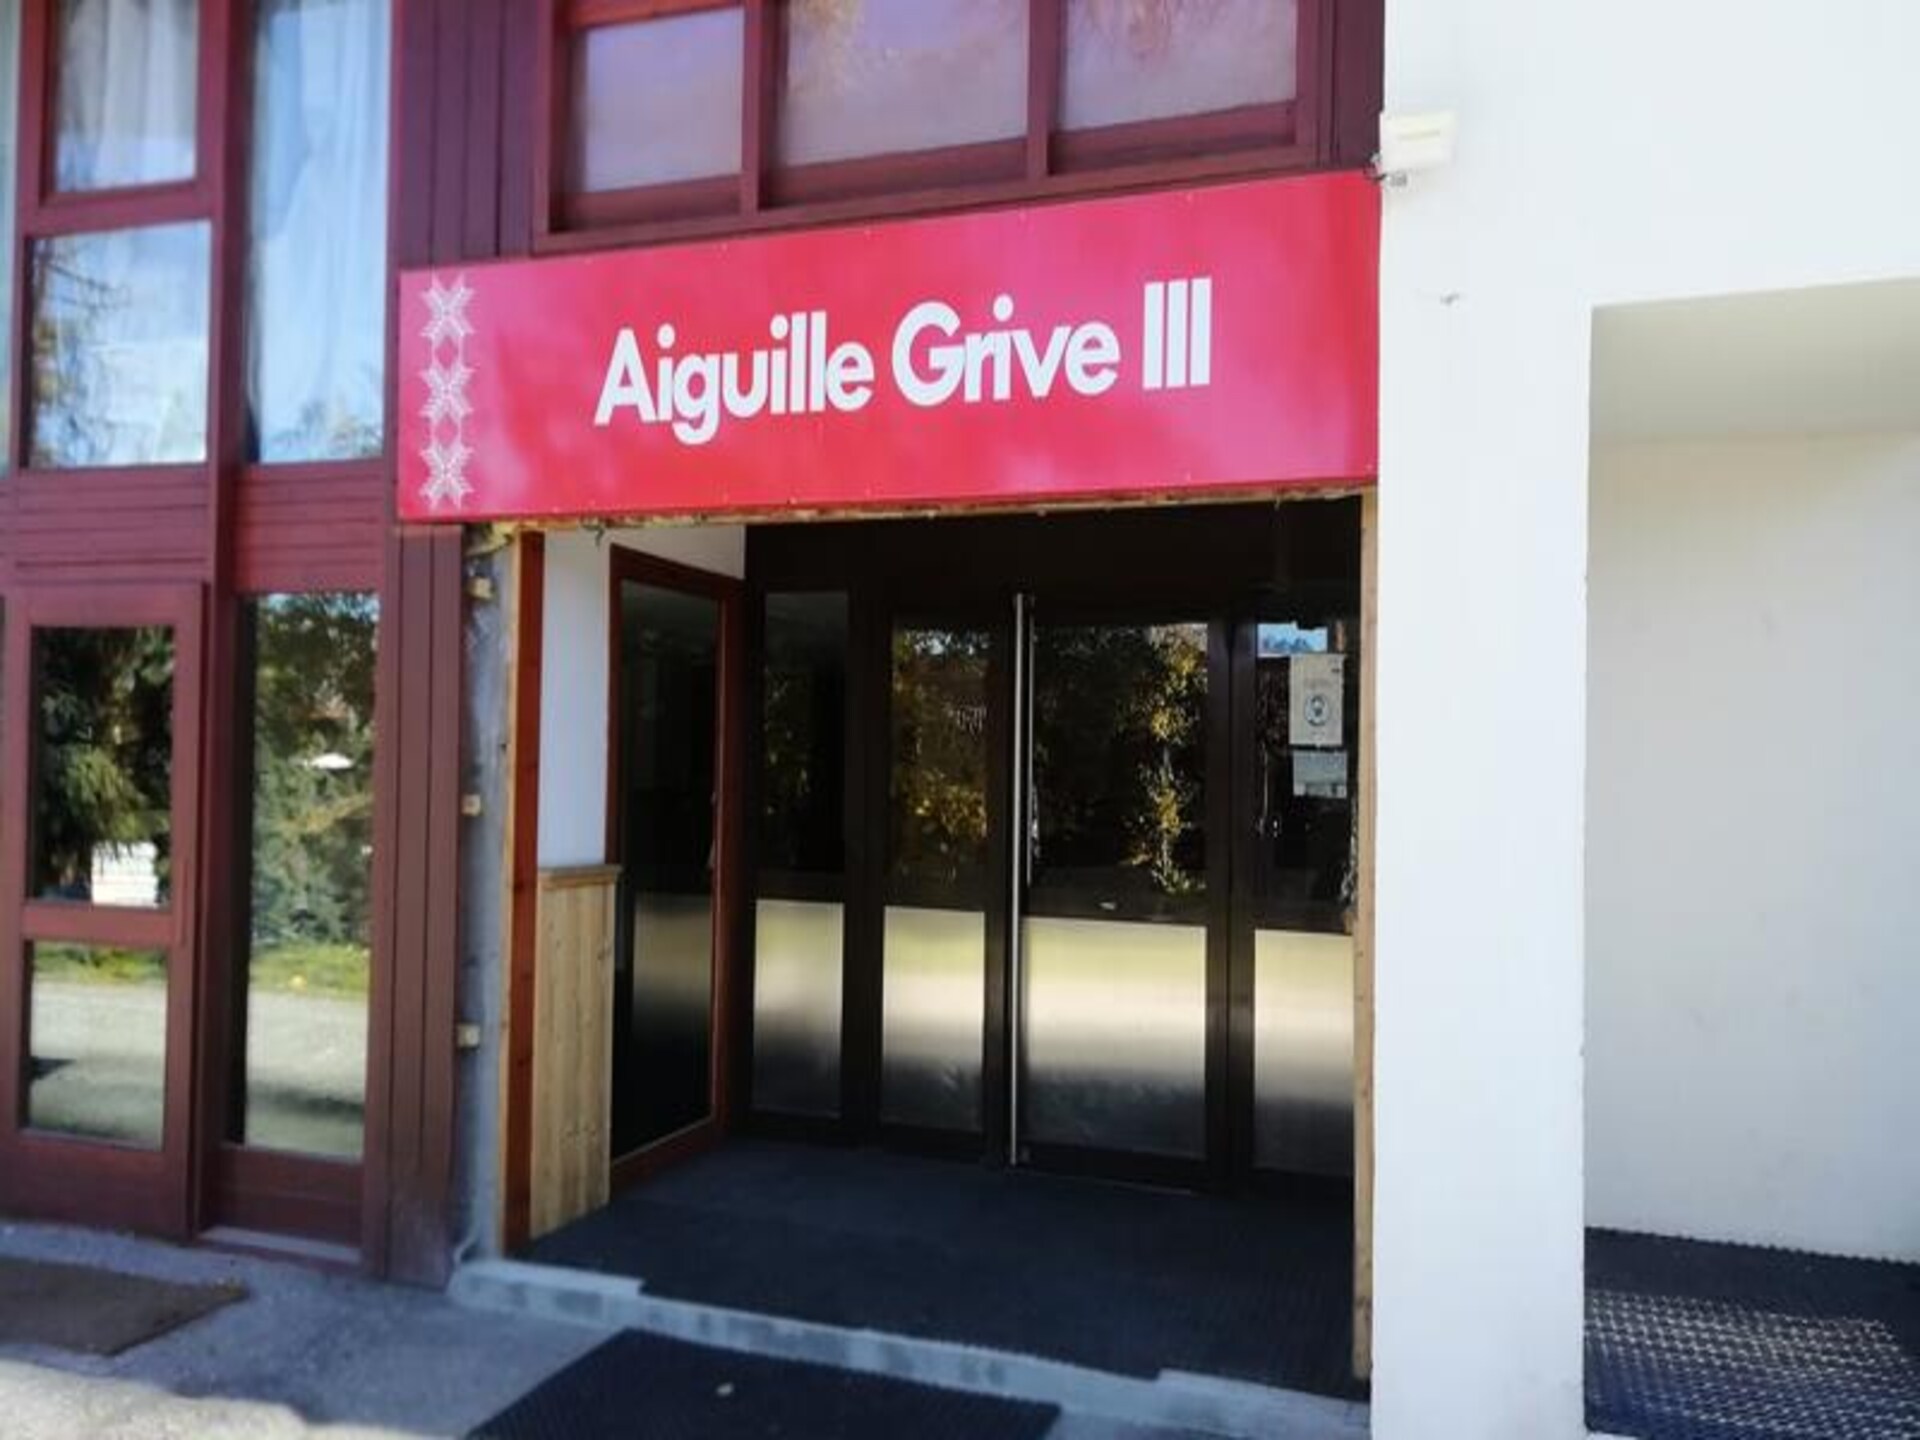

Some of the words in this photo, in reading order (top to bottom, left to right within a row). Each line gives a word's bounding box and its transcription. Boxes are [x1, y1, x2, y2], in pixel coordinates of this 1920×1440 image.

[593, 311, 875, 444] Aiguille
[891, 294, 1121, 407] Grive
[1143, 277, 1212, 390] III
